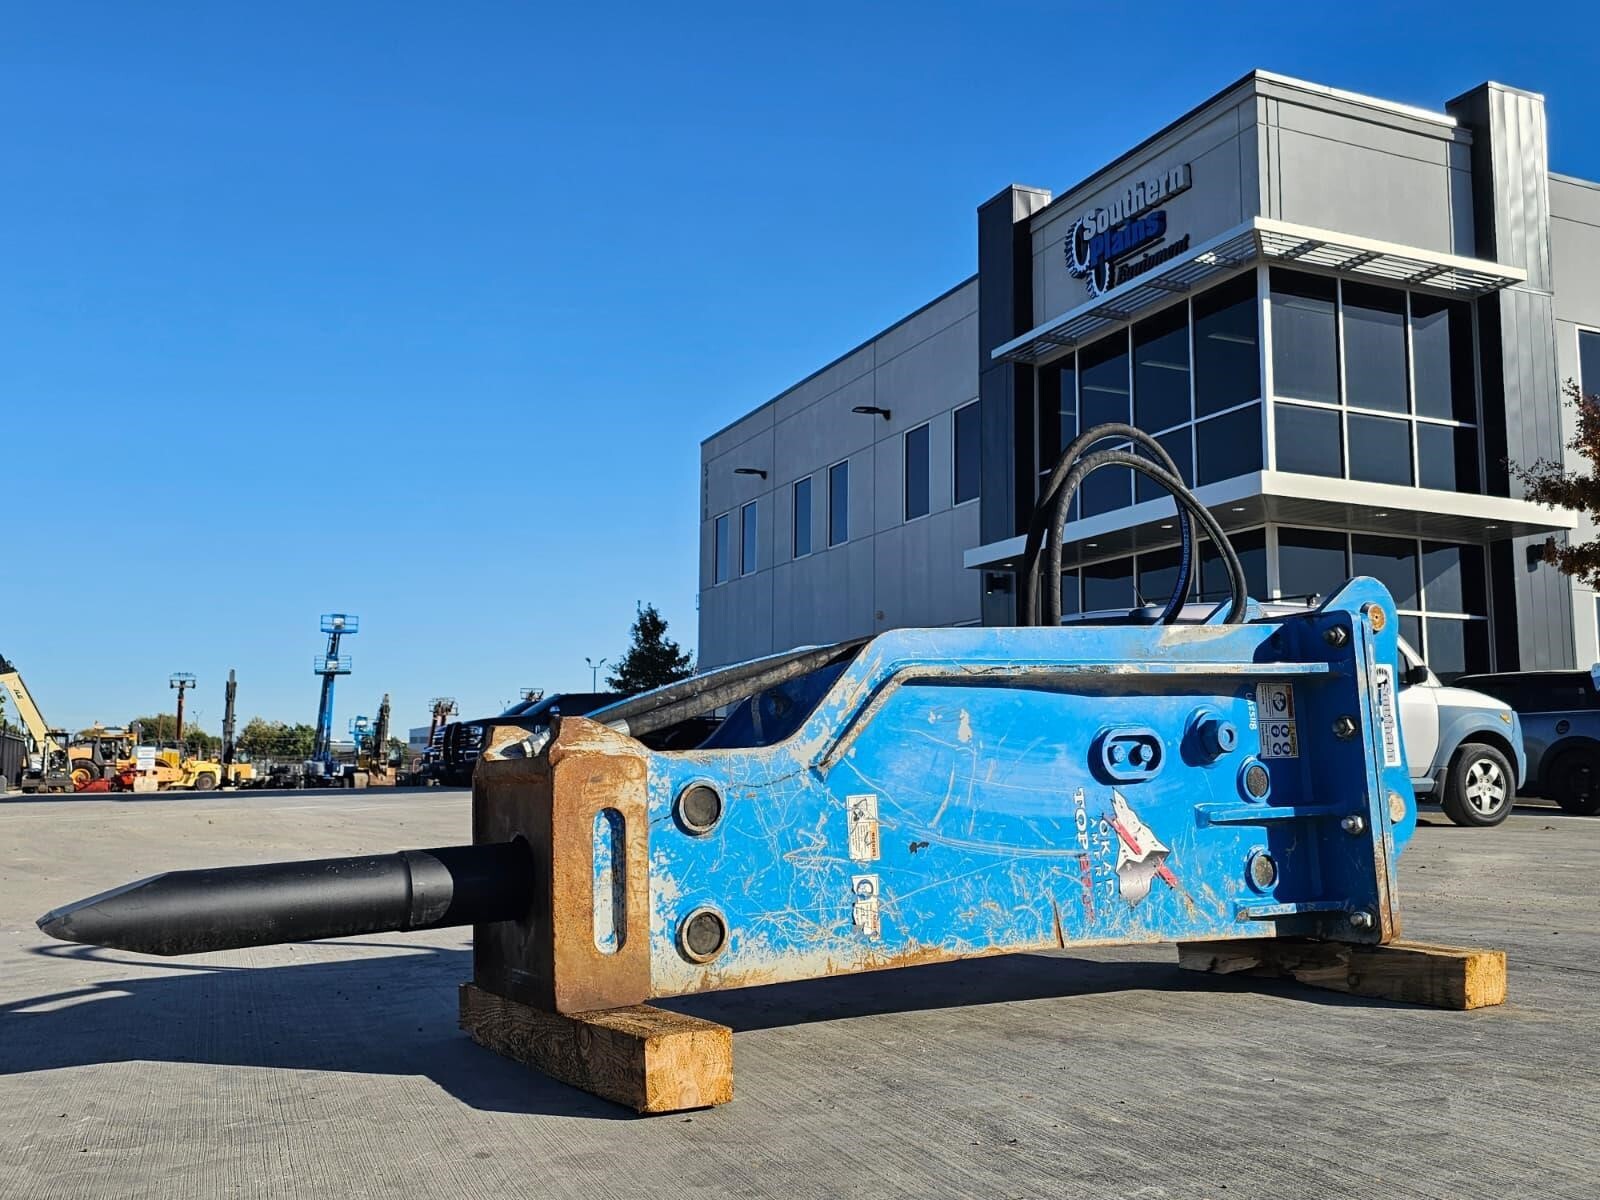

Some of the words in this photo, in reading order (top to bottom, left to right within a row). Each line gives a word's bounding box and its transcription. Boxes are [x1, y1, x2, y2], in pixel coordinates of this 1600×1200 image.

[1082, 163, 1191, 241] Southern
[1088, 211, 1167, 267] Plains
[1117, 233, 1190, 284] Equipment
[1073, 787, 1088, 850] TOP
